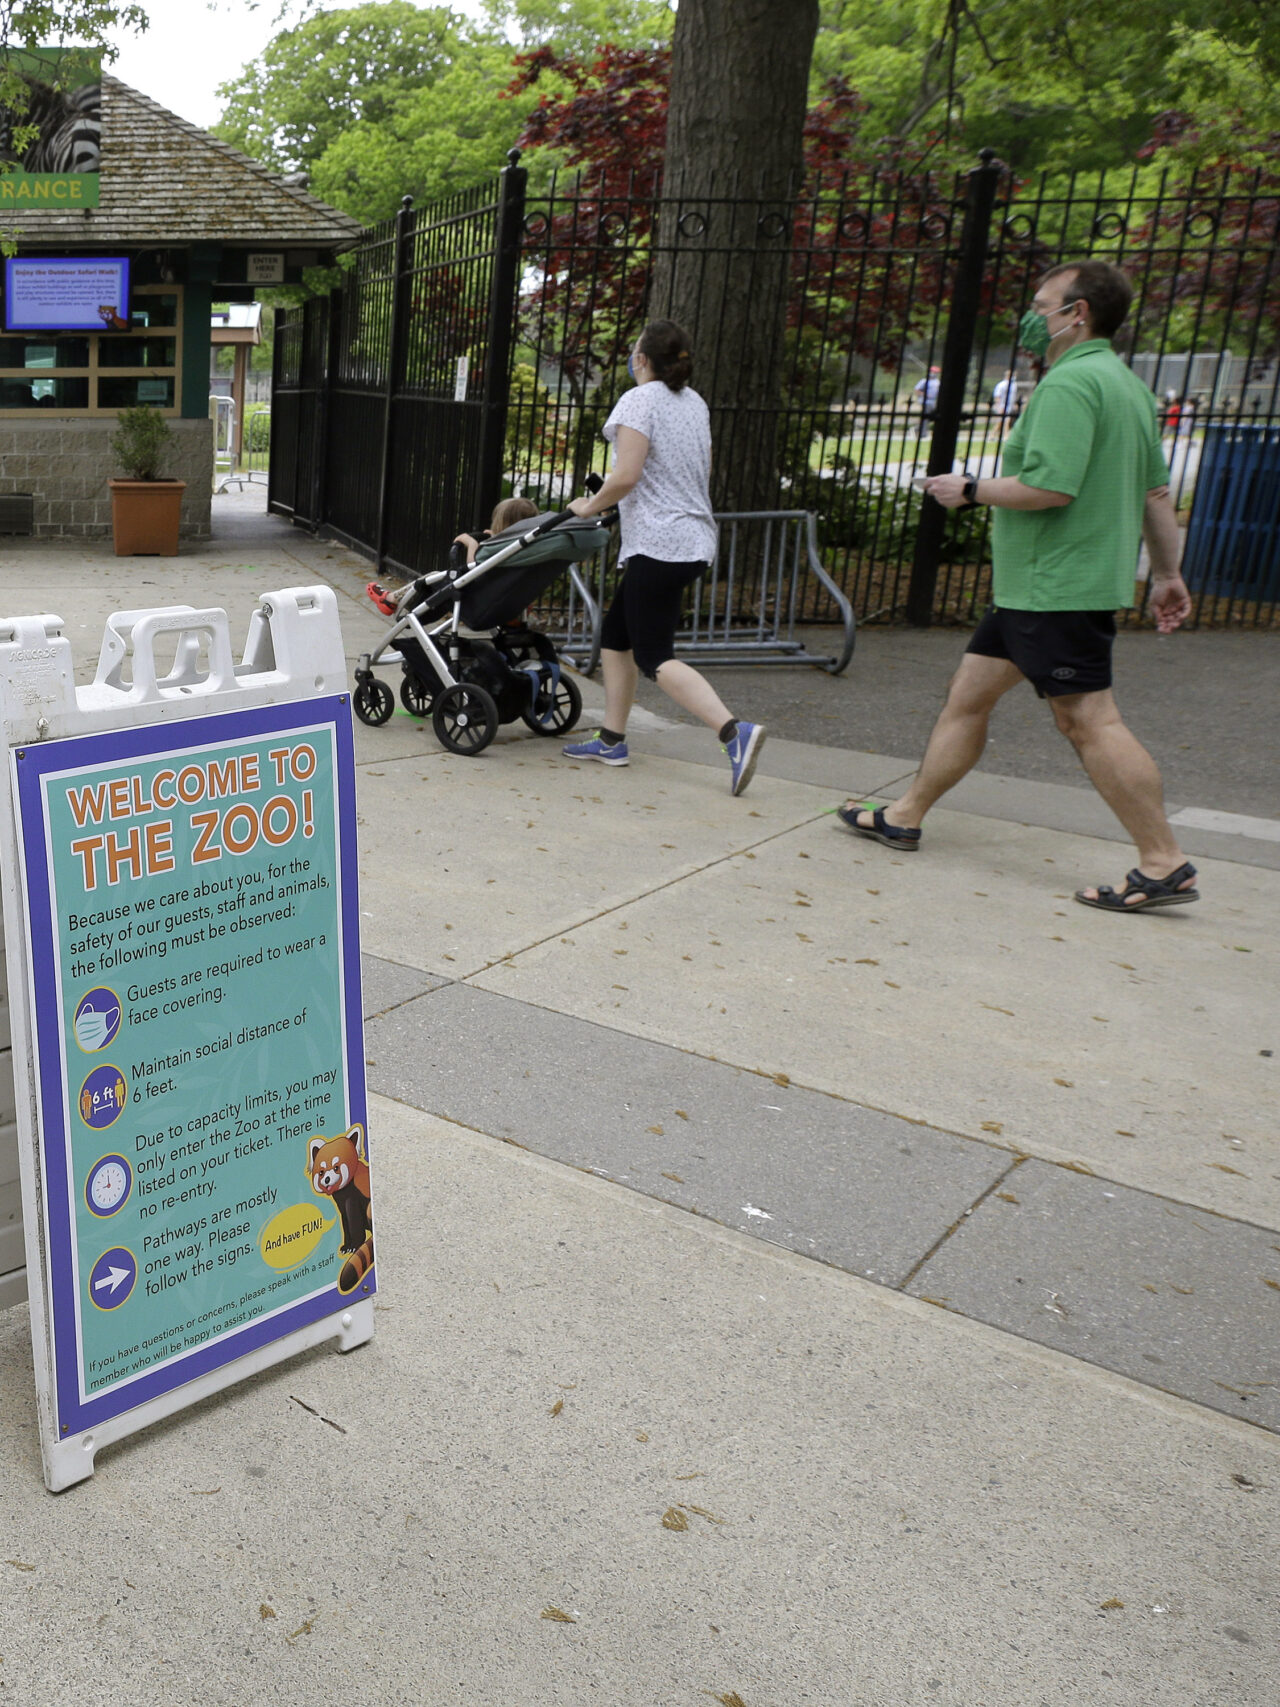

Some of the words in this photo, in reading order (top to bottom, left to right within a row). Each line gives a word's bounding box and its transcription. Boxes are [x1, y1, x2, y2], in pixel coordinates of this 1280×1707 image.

[15, 269, 33, 277] Enjoy
[67, 754, 261, 827] WELCOME
[268, 743, 317, 785] TO
[71, 820, 175, 891] THE
[191, 790, 314, 865] ZOO!
[68, 905, 130, 931] Because
[134, 898, 155, 913] we
[159, 890, 189, 906] care
[193, 876, 233, 898] about
[236, 871, 264, 892] you,
[267, 863, 286, 879] for
[289, 857, 310, 873] the
[70, 932, 113, 954] safety
[117, 921, 132, 941] of
[136, 919, 160, 935] our
[164, 906, 213, 933] guests,
[217, 891, 245, 914] staff
[249, 885, 273, 905] and
[278, 873, 329, 898] animals,
[71, 959, 95, 978] the
[98, 941, 166, 970] following
[171, 928, 205, 949] must
[208, 923, 225, 939] be
[229, 902, 295, 932] observed:
[127, 977, 176, 1001] Guests
[180, 970, 202, 986] are
[206, 946, 262, 978] required
[266, 947, 280, 960] to
[284, 937, 315, 955] wear
[319, 934, 325, 945] a
[127, 1007, 158, 1025] face
[162, 987, 226, 1014] covering.
[131, 1048, 191, 1080] Maintain
[195, 1031, 232, 1058] social
[236, 1018, 289, 1044] distance
[293, 1007, 306, 1025] of
[92, 1091, 99, 1104] 6
[103, 1086, 113, 1100] ft
[132, 1086, 141, 1103] 6
[145, 1077, 177, 1099] feet.
[135, 1132, 164, 1151] Due
[167, 1125, 182, 1139] to
[187, 1103, 241, 1131] capacity
[245, 1089, 281, 1110] limits,
[285, 1079, 308, 1100] you
[312, 1068, 336, 1086] may
[137, 1151, 165, 1173] only
[170, 1138, 205, 1160] enter
[209, 1128, 230, 1145] the
[234, 1119, 260, 1136] Zoo
[264, 1110, 276, 1125] at
[279, 1103, 300, 1119] the
[303, 1092, 330, 1110] time
[138, 1167, 175, 1196] listed
[179, 1165, 196, 1179] on
[200, 1151, 230, 1176] your
[233, 1135, 272, 1158] ticket.
[276, 1121, 312, 1141] There
[316, 1113, 325, 1127] is
[139, 1203, 157, 1219] no
[161, 1180, 216, 1210] re-entry.
[143, 1217, 207, 1252] Pathways
[211, 1207, 231, 1224] are
[235, 1186, 277, 1214] mostly
[265, 1234, 281, 1252] And
[282, 1230, 300, 1244] have
[301, 1217, 322, 1236] FUN!
[144, 1255, 170, 1274] one
[174, 1241, 203, 1261] way.
[208, 1221, 250, 1247] Please
[145, 1269, 187, 1296] follow
[191, 1259, 213, 1276] the
[217, 1243, 253, 1265] signs.
[89, 1359, 96, 1372] If
[98, 1355, 115, 1371] you
[117, 1344, 139, 1359] have
[141, 1324, 184, 1349] questions
[186, 1318, 195, 1328] or
[197, 1301, 237, 1323] concerns,
[239, 1287, 266, 1307] please
[267, 1273, 291, 1292] speak
[292, 1265, 309, 1280] with
[317, 1252, 334, 1269] staff
[90, 1365, 129, 1389] member
[131, 1356, 151, 1370] who
[152, 1345, 167, 1360] will
[170, 1342, 181, 1352] be
[183, 1328, 210, 1346] happy
[212, 1324, 221, 1333] to
[224, 1311, 246, 1328] assist
[247, 1304, 265, 1320] you.
